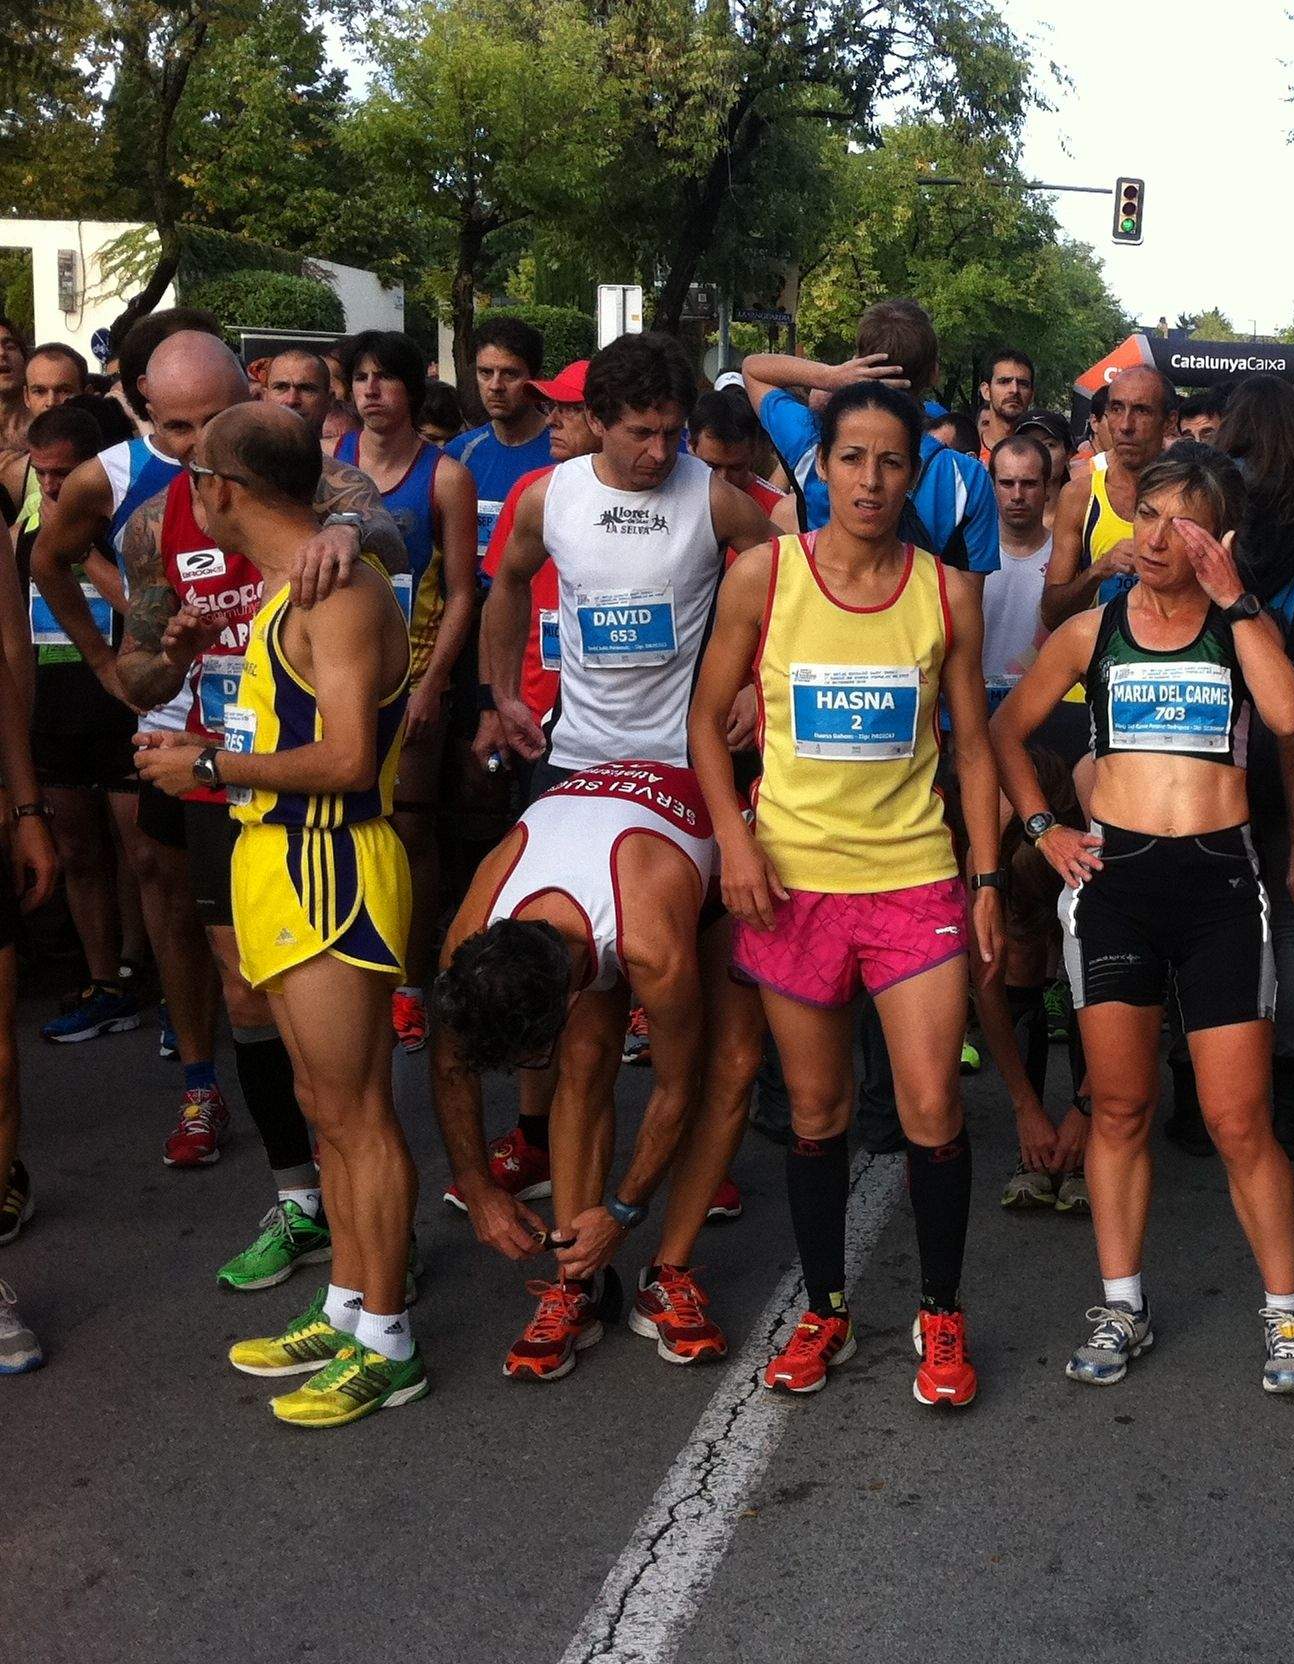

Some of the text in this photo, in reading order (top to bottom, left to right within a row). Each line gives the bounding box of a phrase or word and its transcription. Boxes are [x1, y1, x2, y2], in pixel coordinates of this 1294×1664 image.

[1171, 354, 1287, 373] CatalunyaCaixa
[606, 524, 650, 535] LA SELVA
[593, 609, 652, 627] DAVID
[610, 629, 638, 643] 653
[816, 690, 895, 710] HASNA
[1114, 684, 1227, 706] MARIA DEL CARME
[851, 714, 862, 730] 2
[1154, 706, 1186, 721] 703
[609, 781, 696, 826] SERVEI
